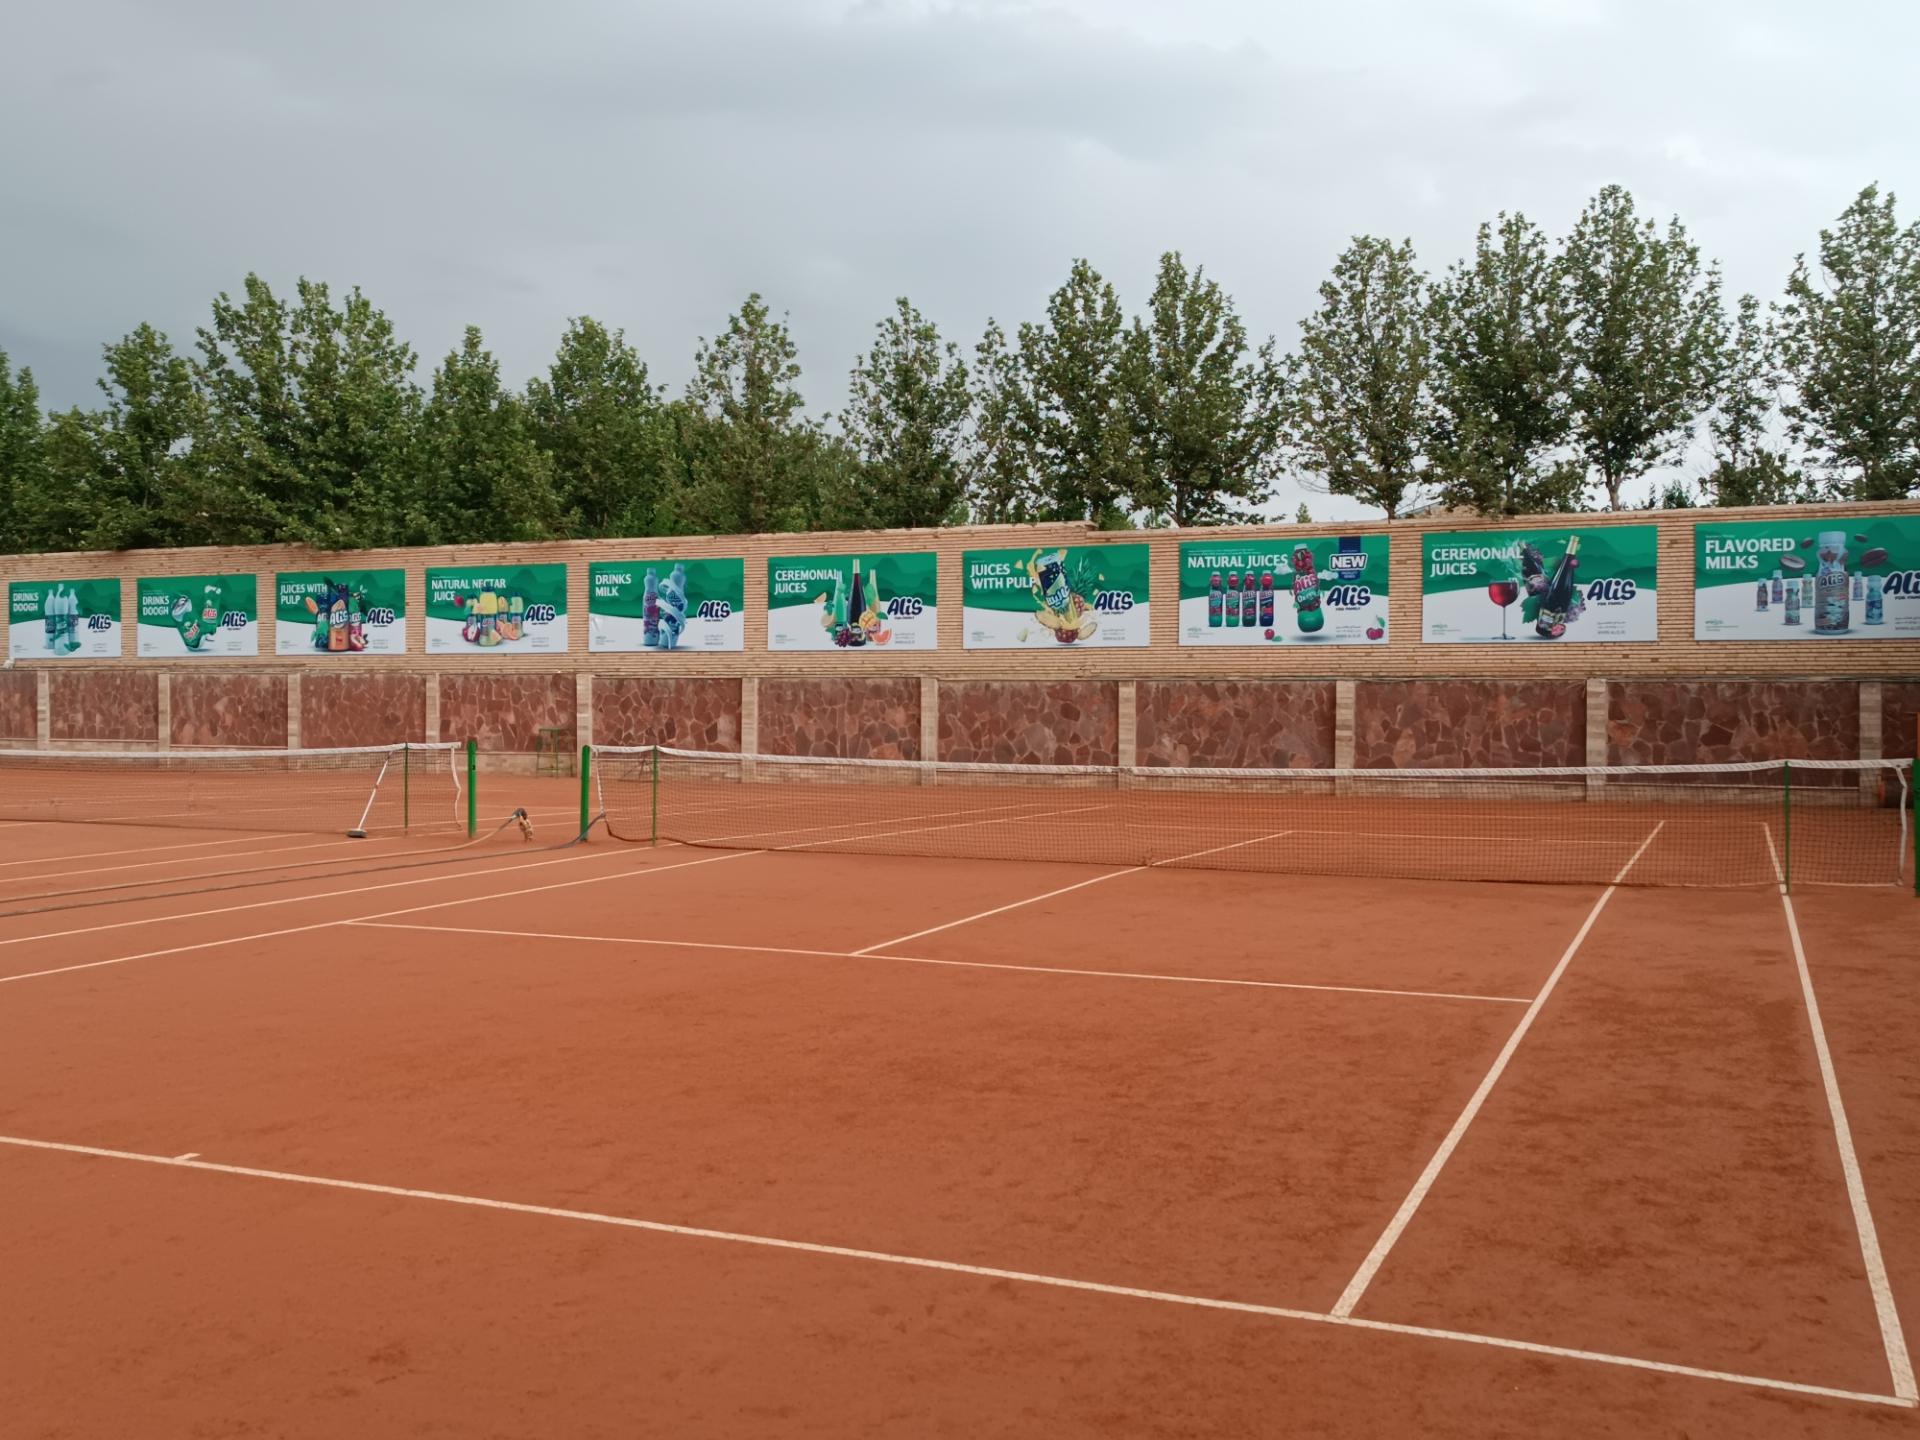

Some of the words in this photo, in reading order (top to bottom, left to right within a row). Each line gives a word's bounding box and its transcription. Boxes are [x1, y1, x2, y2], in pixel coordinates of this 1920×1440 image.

[1705, 538, 1796, 553] FLAVORED
[1431, 547, 1524, 561] CEREMONIAL
[1187, 556, 1245, 568] NATURAL
[1246, 554, 1288, 569] JUICES
[1331, 555, 1366, 569] NEW
[1705, 555, 1759, 570] MILKS
[774, 569, 838, 581] CEREMONIAL
[970, 563, 1010, 577] JUICES
[1430, 562, 1477, 578] JUICES
[431, 579, 470, 590] NATURAL
[472, 578, 507, 589] NECTAR
[595, 574, 632, 585] DRINKS
[971, 577, 1004, 589] WITH
[1006, 576, 1036, 589] PULP
[280, 584, 305, 594] JUICES
[306, 583, 328, 593] WITH
[595, 586, 619, 597] MILK
[774, 582, 807, 595] JUICES
[12, 592, 39, 602] DRINKS
[142, 596, 170, 605] DRINKS
[280, 595, 301, 605] PULP
[432, 591, 456, 602] JUICE
[12, 602, 38, 612] DOOGH
[142, 606, 169, 616] DOOGH
